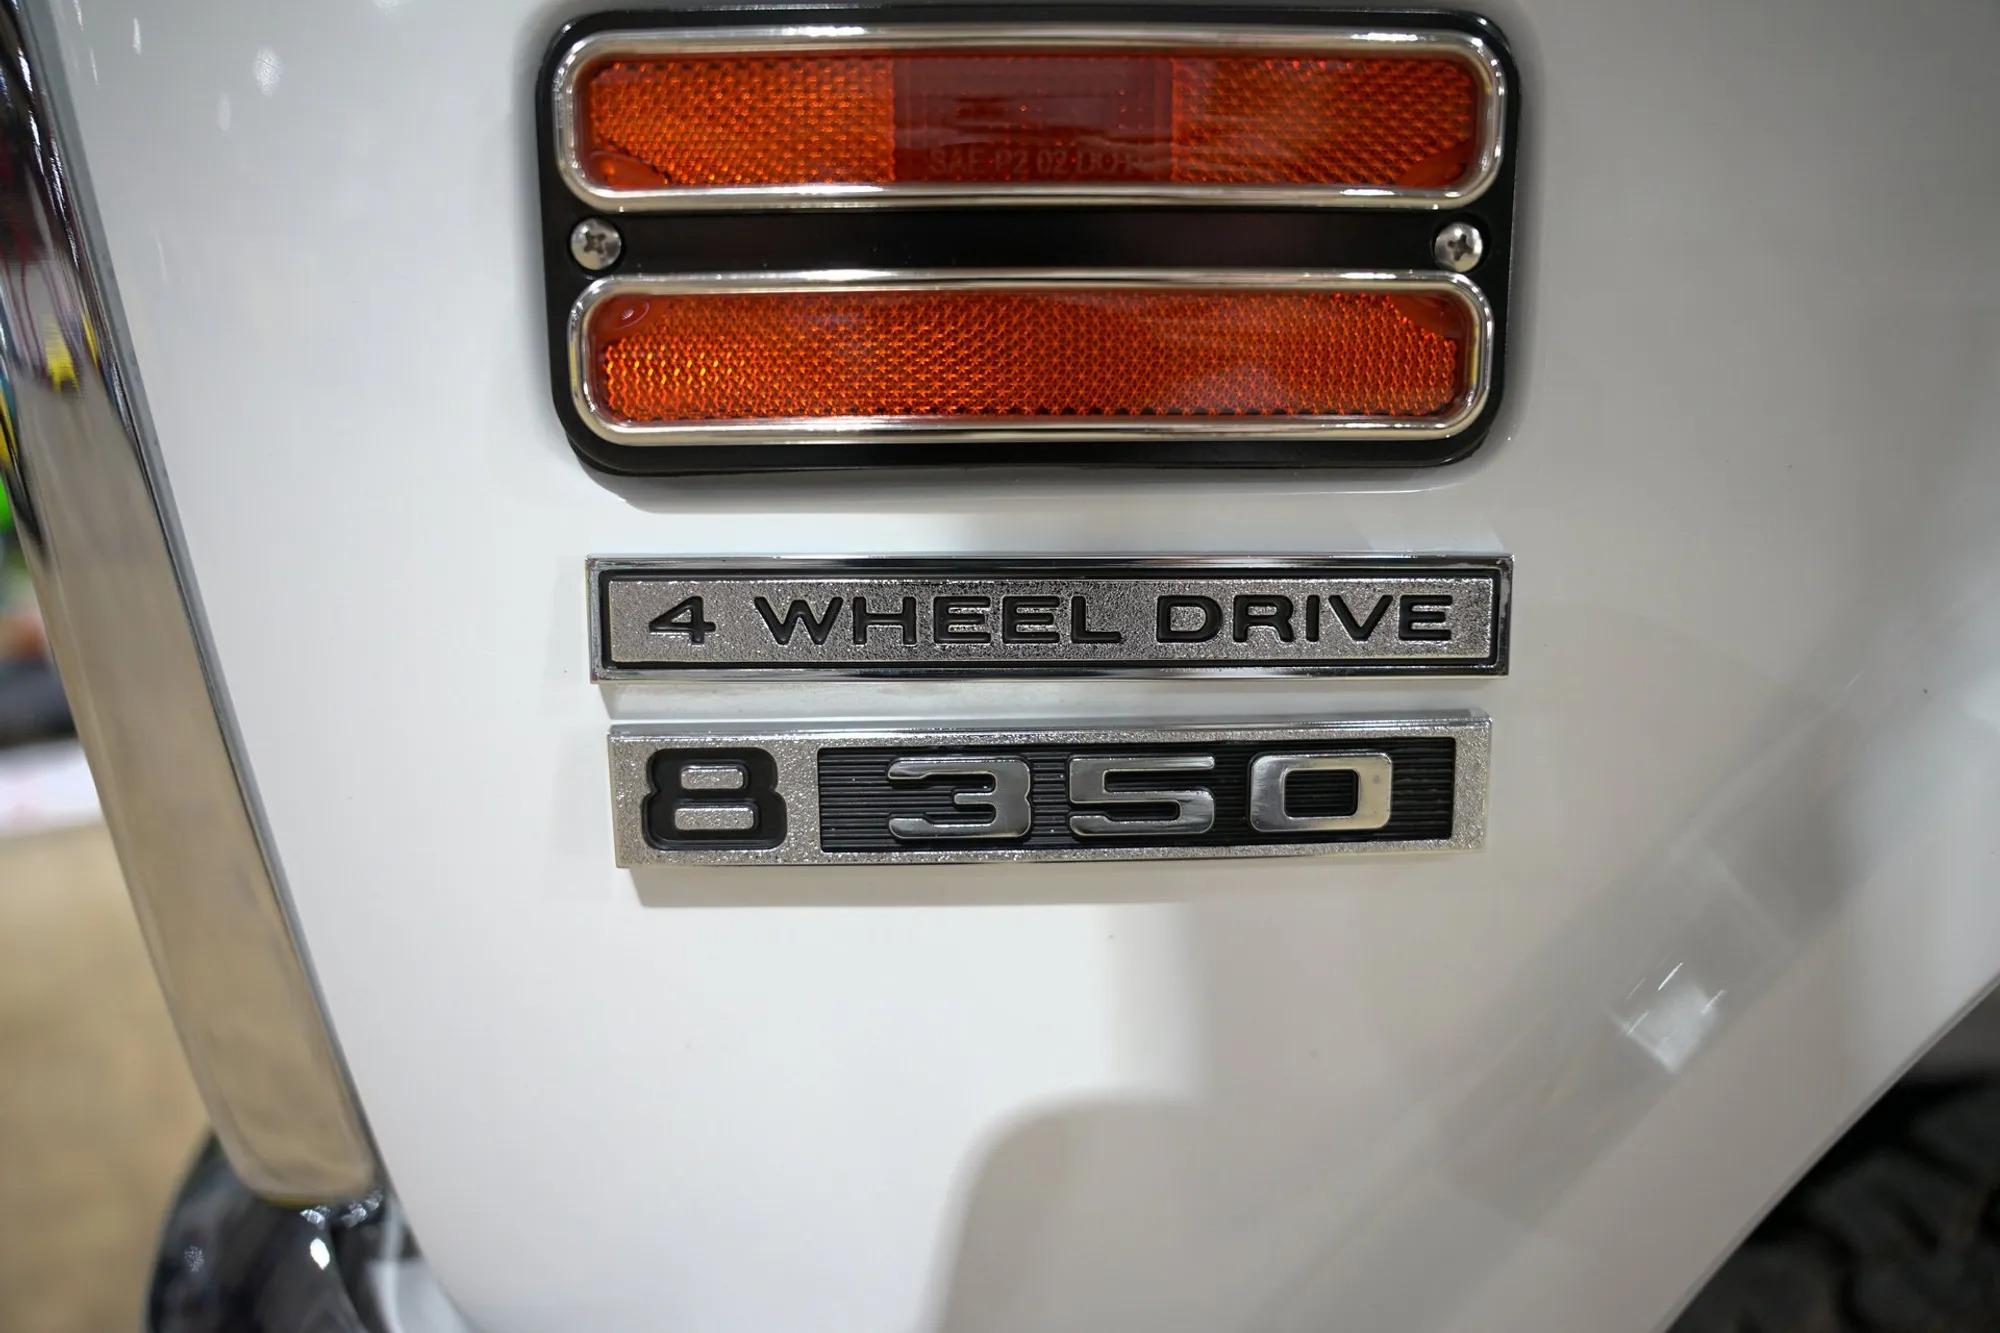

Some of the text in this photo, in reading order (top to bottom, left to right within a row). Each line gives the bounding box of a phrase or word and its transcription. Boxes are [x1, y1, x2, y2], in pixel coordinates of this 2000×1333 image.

[927, 148, 986, 175] SAE
[649, 594, 1454, 645] 4 WHEEL DRIVE
[641, 747, 1393, 852] 8 350
